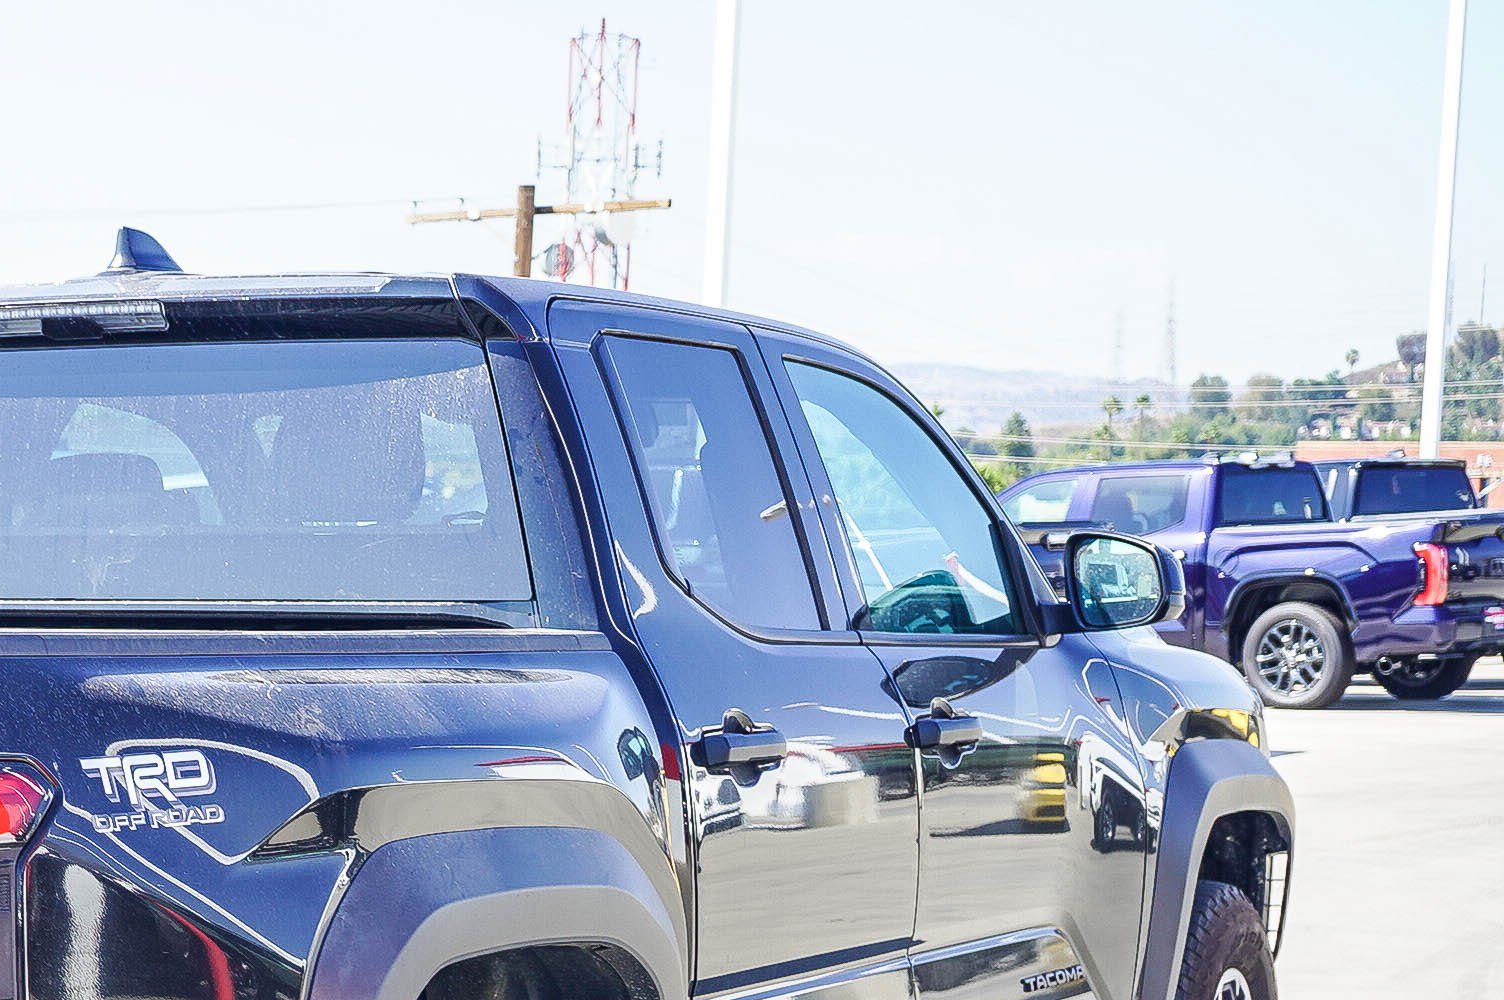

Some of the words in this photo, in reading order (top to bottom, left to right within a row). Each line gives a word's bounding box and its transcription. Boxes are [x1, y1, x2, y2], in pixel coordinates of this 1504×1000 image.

[80, 749, 217, 809] TRD
[93, 813, 147, 833] OFF
[151, 804, 225, 830] ROAD
